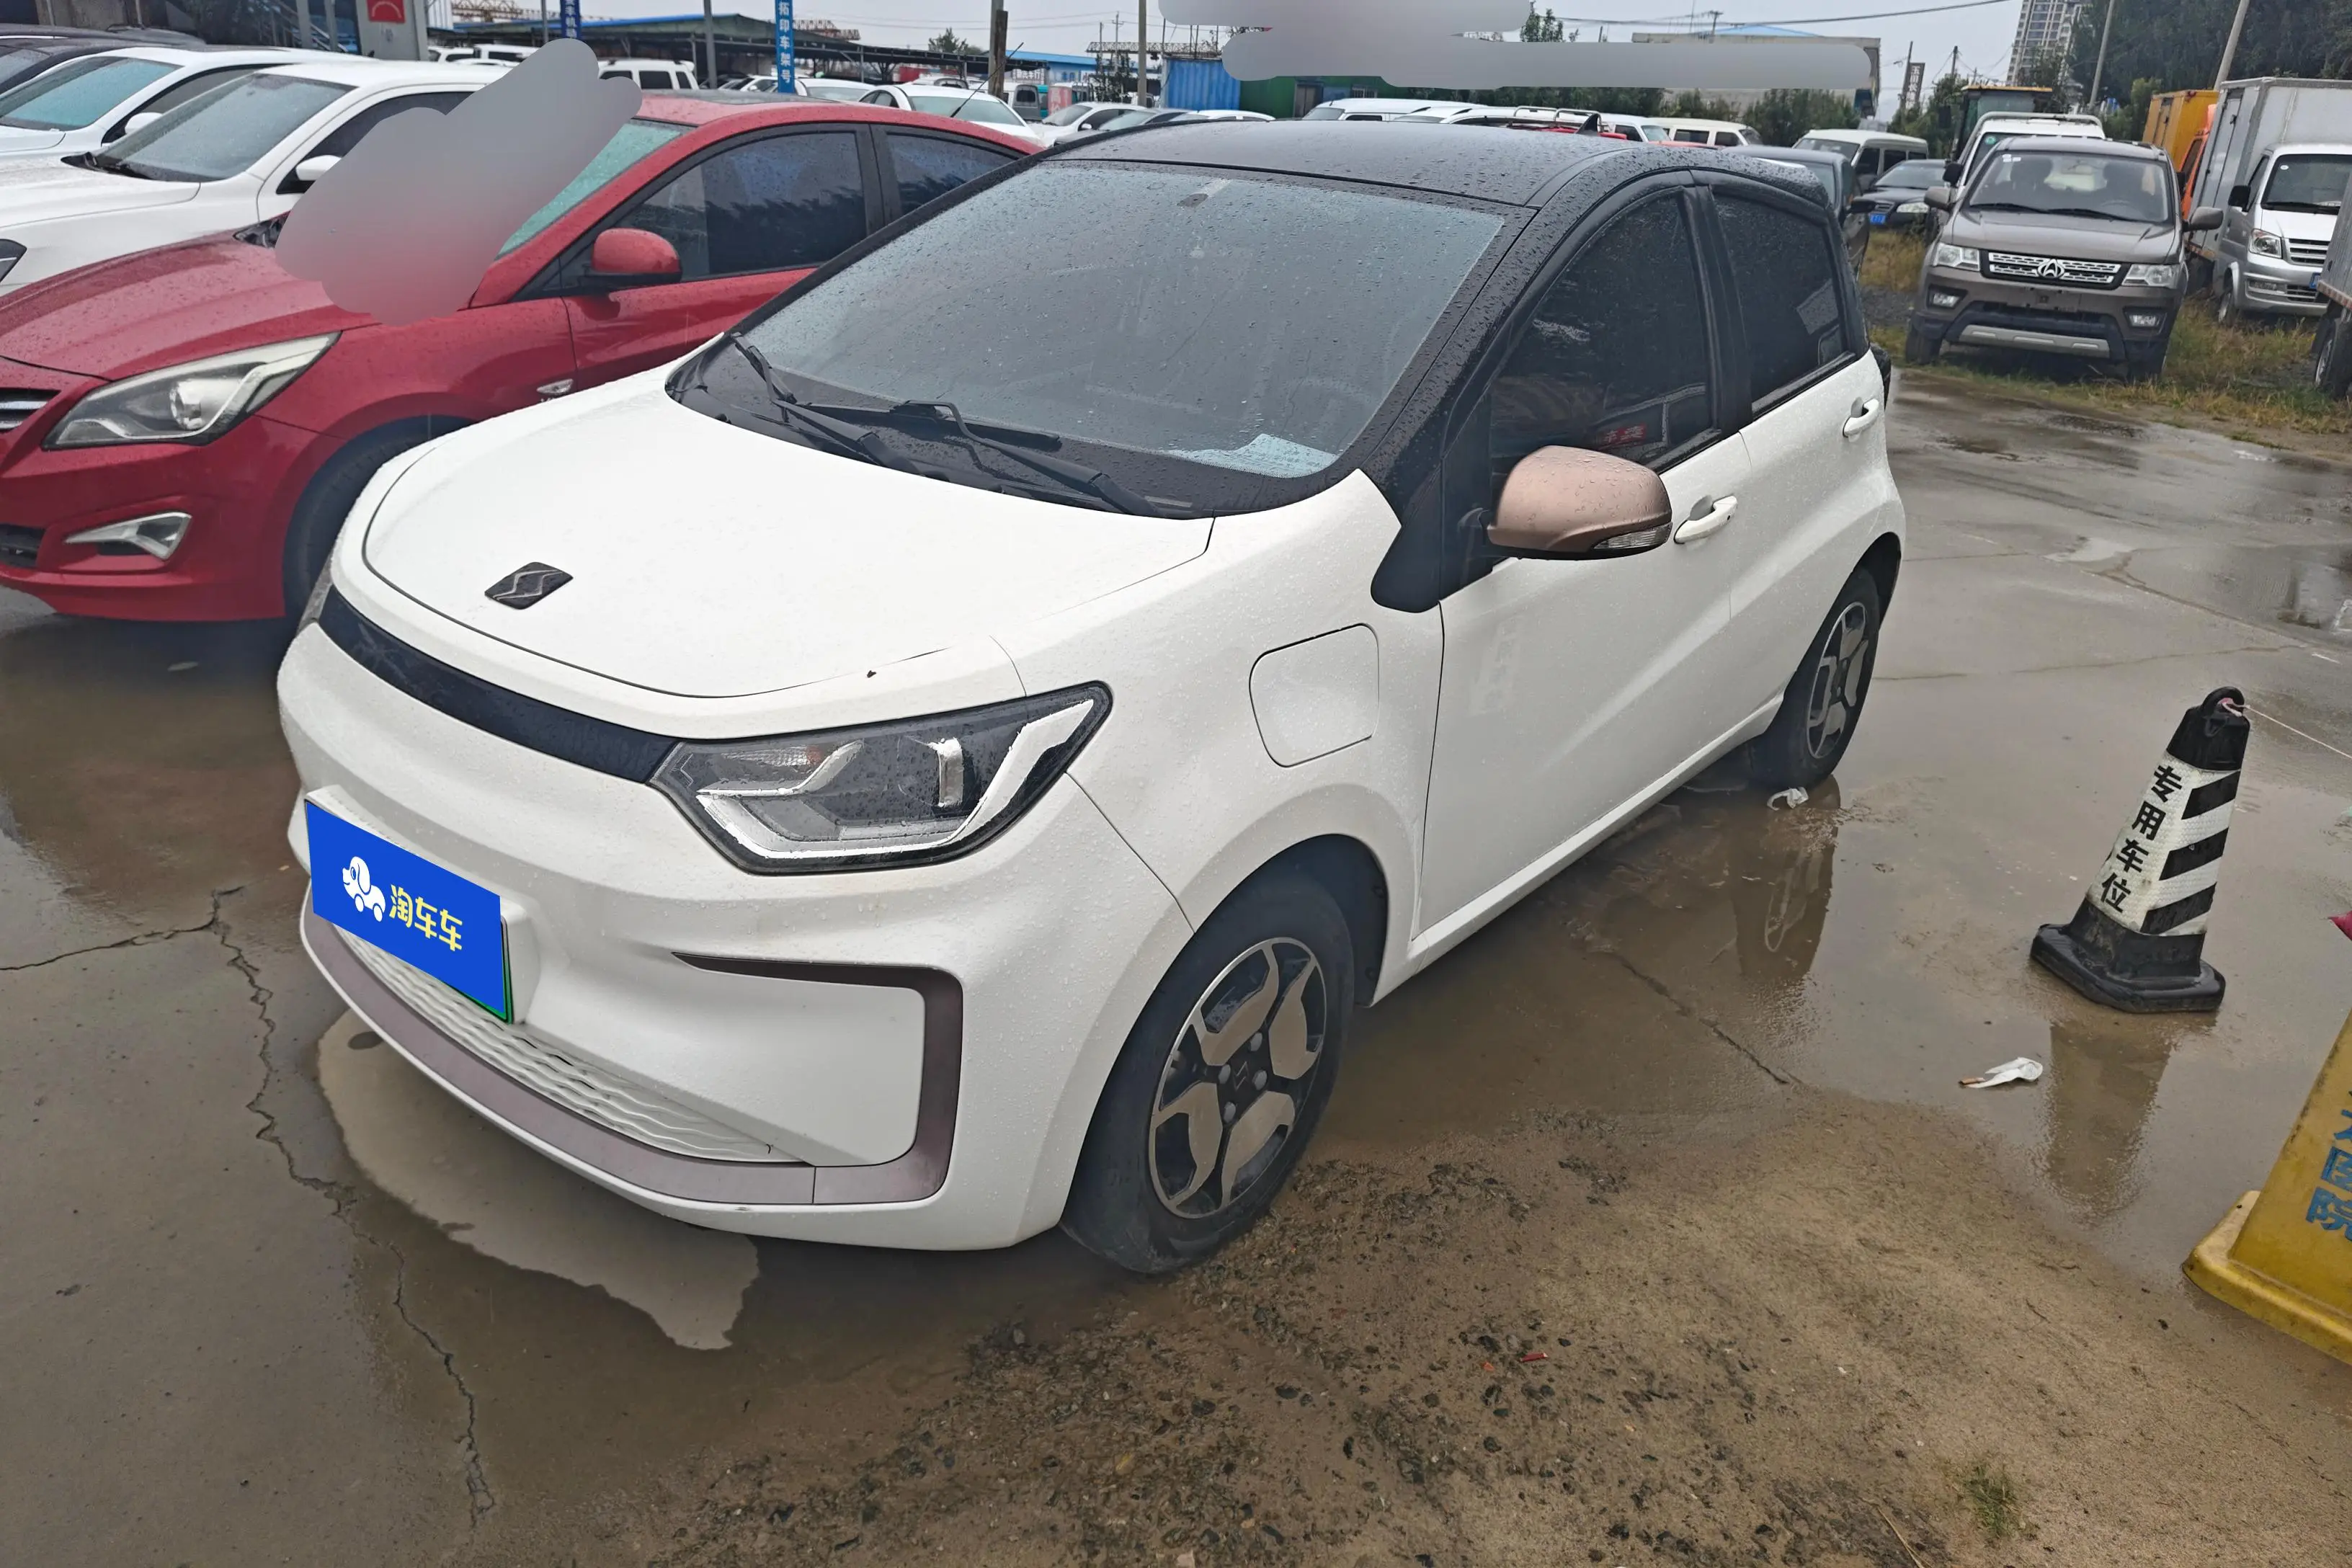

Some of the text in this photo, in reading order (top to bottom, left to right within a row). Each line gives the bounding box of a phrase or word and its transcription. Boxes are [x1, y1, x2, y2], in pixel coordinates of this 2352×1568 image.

[778, 1, 791, 84] 拓印车架号
[2101, 765, 2182, 914] 专用车位
